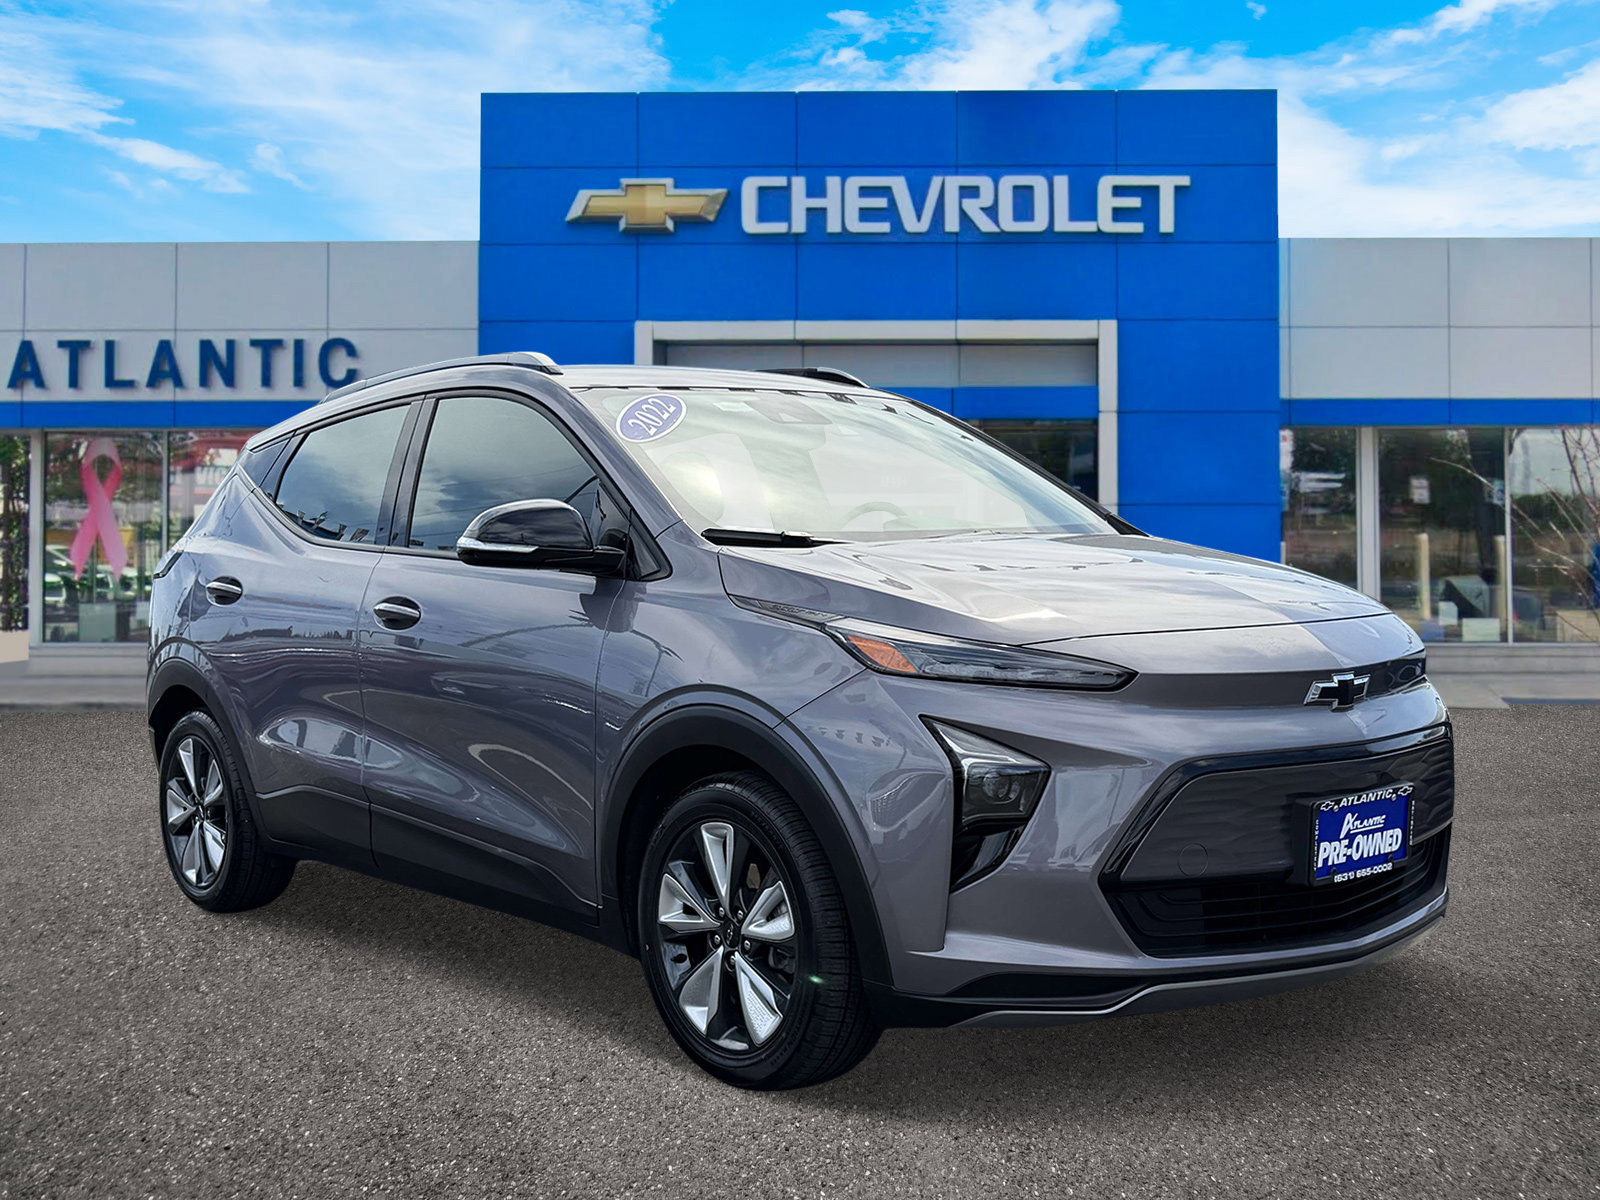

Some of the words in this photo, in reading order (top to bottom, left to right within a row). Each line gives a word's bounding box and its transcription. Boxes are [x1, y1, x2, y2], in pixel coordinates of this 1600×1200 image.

[741, 175, 1191, 234] CHEVROLET
[7, 338, 362, 389] ATLANTIC
[628, 398, 676, 436] 2022
[1339, 789, 1394, 807] ATLANTIC
[1317, 828, 1402, 868] PRE-OWNED
